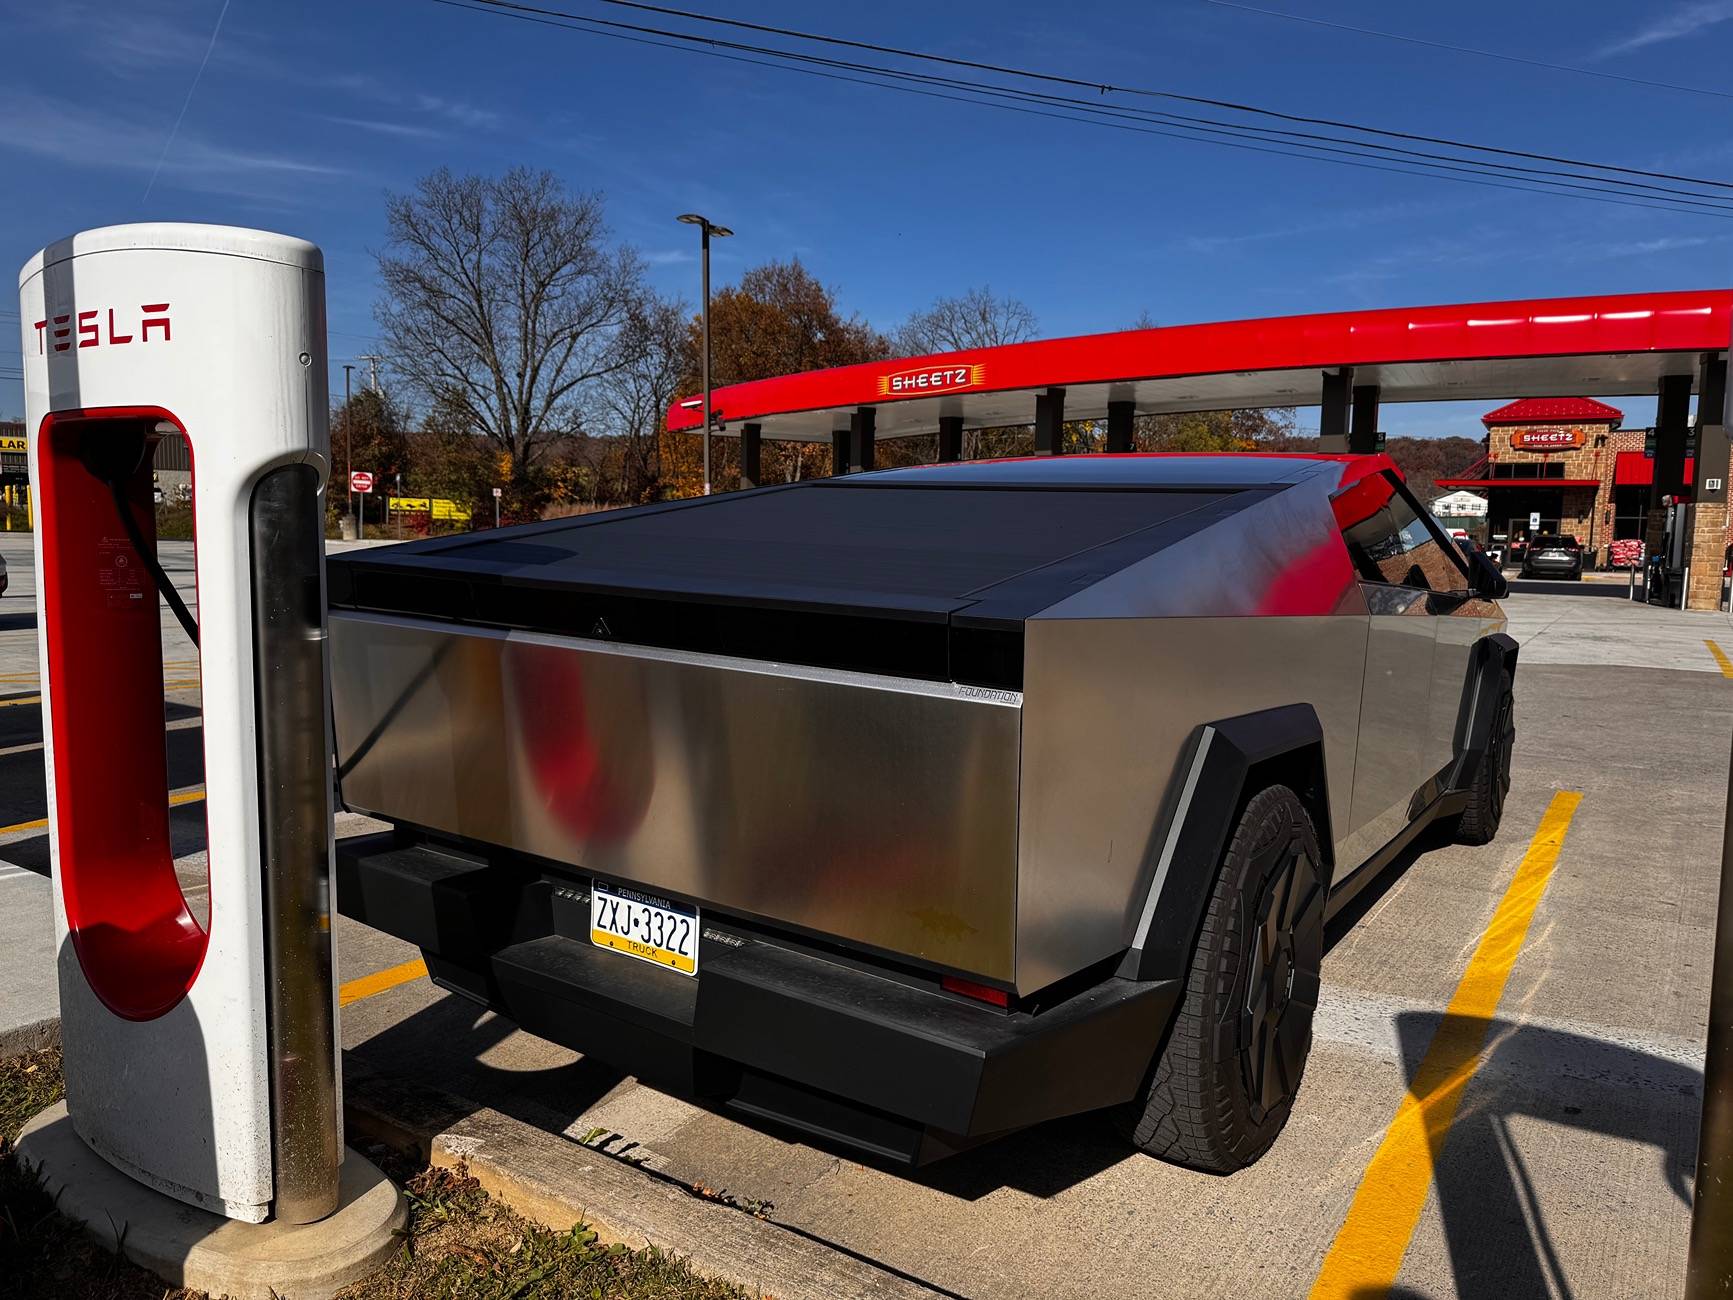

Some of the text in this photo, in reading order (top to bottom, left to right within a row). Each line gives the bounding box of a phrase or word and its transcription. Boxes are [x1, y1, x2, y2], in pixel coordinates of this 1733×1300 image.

[34, 303, 171, 355] TESLA
[892, 369, 967, 390] SHEETZ
[1523, 433, 1573, 442] SHEETZ
[959, 686, 1018, 702] FOUNDATION
[618, 888, 671, 909] PENNSYLVANIA
[626, 939, 658, 958] TRUCK
